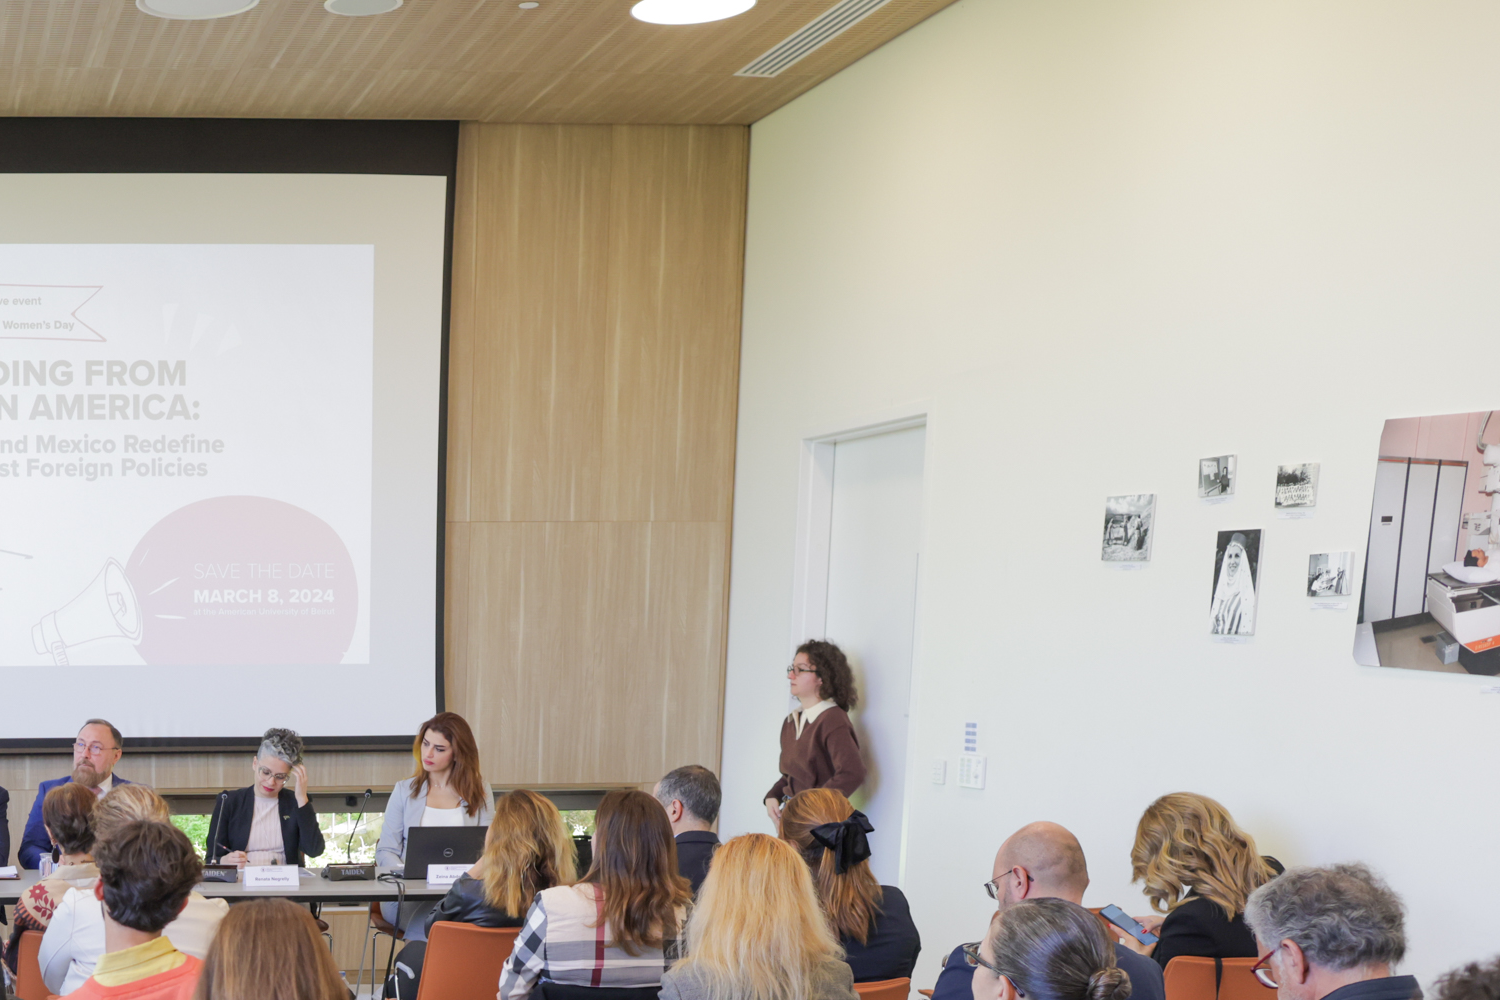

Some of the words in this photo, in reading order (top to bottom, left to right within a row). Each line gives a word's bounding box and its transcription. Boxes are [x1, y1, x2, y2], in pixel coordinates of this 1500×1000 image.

[12, 297, 42, 306] event
[2, 320, 51, 330] Women’s
[53, 320, 75, 332] Day
[85, 360, 187, 387] FROM
[29, 394, 201, 421] AMERICA:
[35, 433, 117, 454] Mexico
[123, 433, 225, 454] Redefine
[27, 457, 114, 482] Foreign
[121, 457, 209, 478] Policies
[194, 563, 241, 579] SAVE
[247, 563, 282, 579] THE
[288, 562, 335, 579] DATE
[194, 589, 262, 604] MARCH
[267, 589, 284, 606] 8,
[289, 588, 335, 604] 2024
[193, 608, 201, 616] at
[203, 608, 216, 616] the
[218, 608, 257, 616] American
[259, 607, 298, 617] University
[300, 608, 309, 616] of
[311, 607, 336, 616] Beirut
